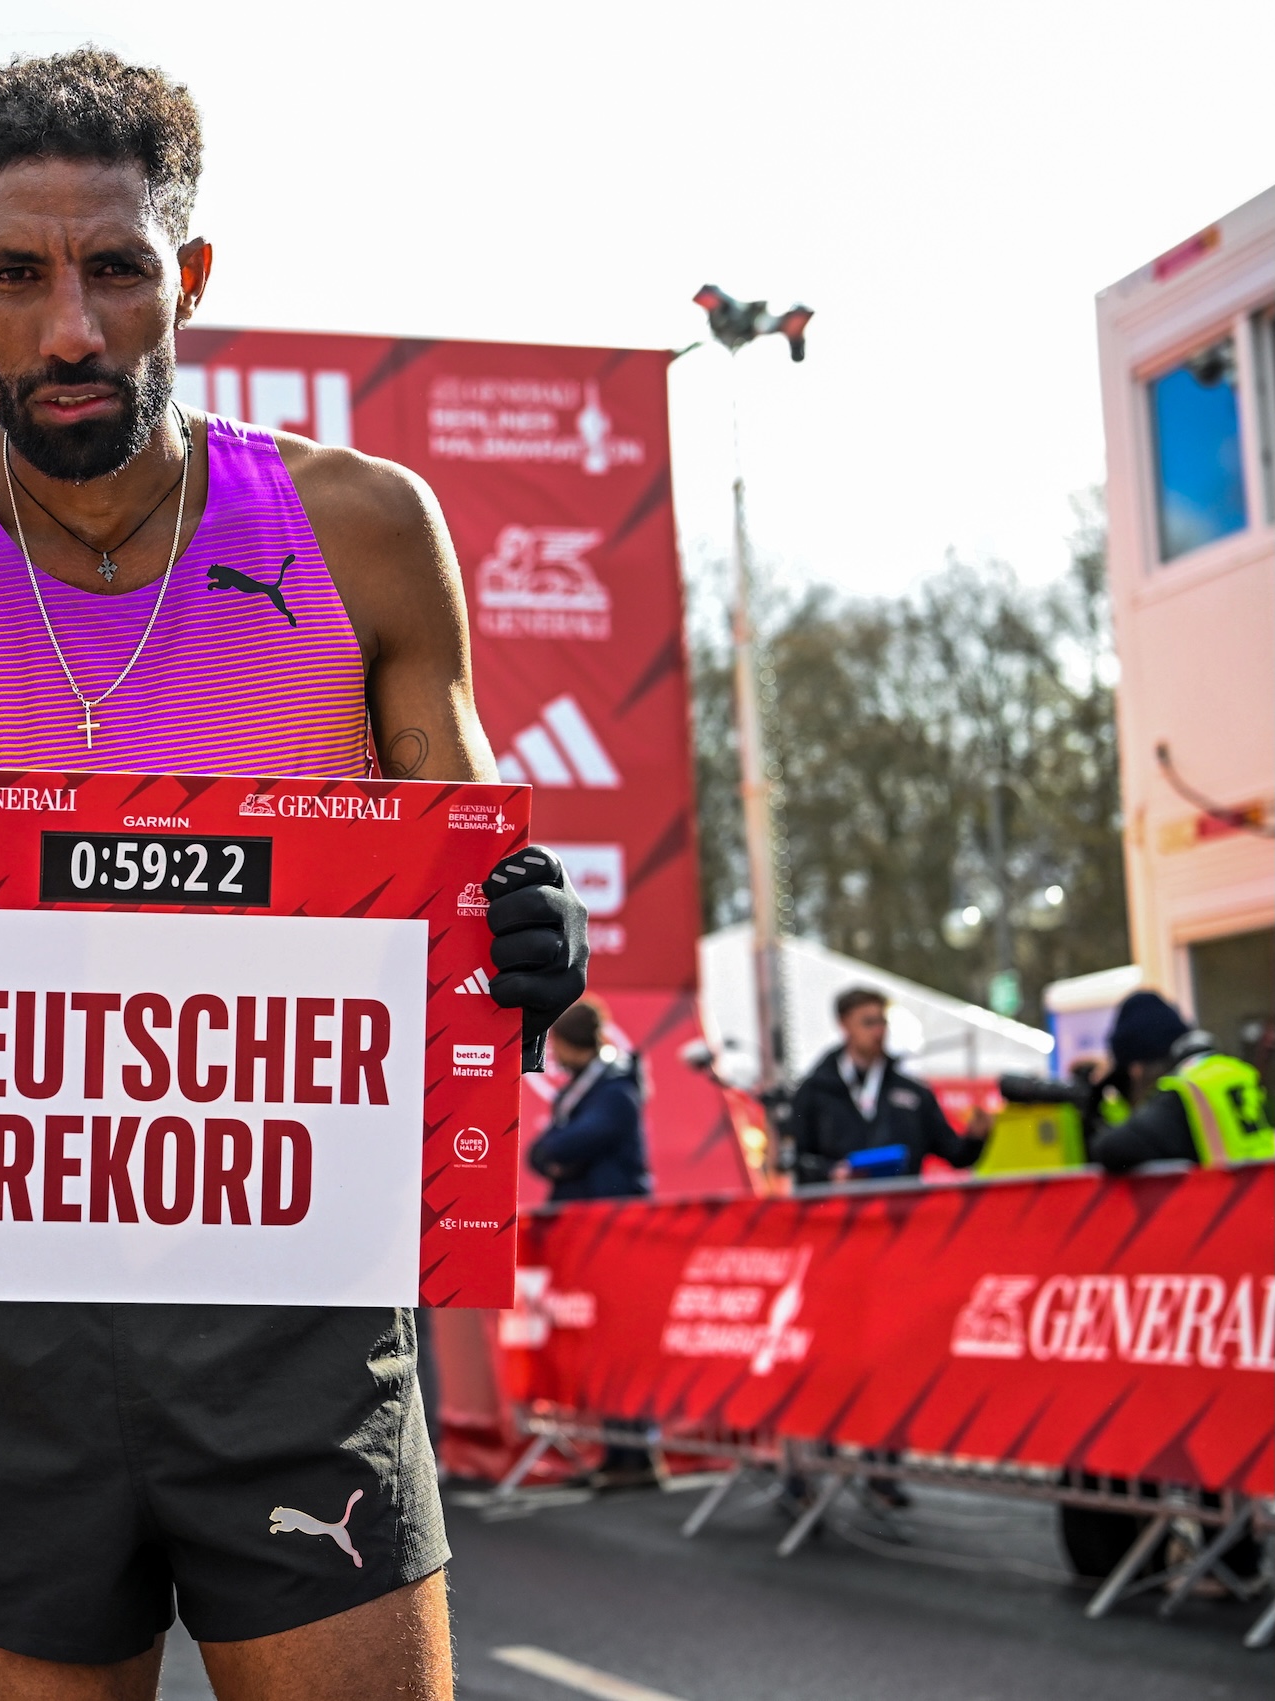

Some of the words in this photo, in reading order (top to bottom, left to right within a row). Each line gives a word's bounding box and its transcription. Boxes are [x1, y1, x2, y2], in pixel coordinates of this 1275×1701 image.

[278, 795, 401, 821] GENERALI
[460, 805, 496, 813] GENERALI
[123, 815, 190, 828] GARMIN
[448, 813, 488, 821] BERLINER
[448, 822, 515, 831] HALBMARATON
[70, 841, 245, 894] 0:59:22
[457, 908, 488, 917] GENER
[453, 1067, 493, 1077] Matratze
[1029, 1273, 1275, 1372] GENERA
